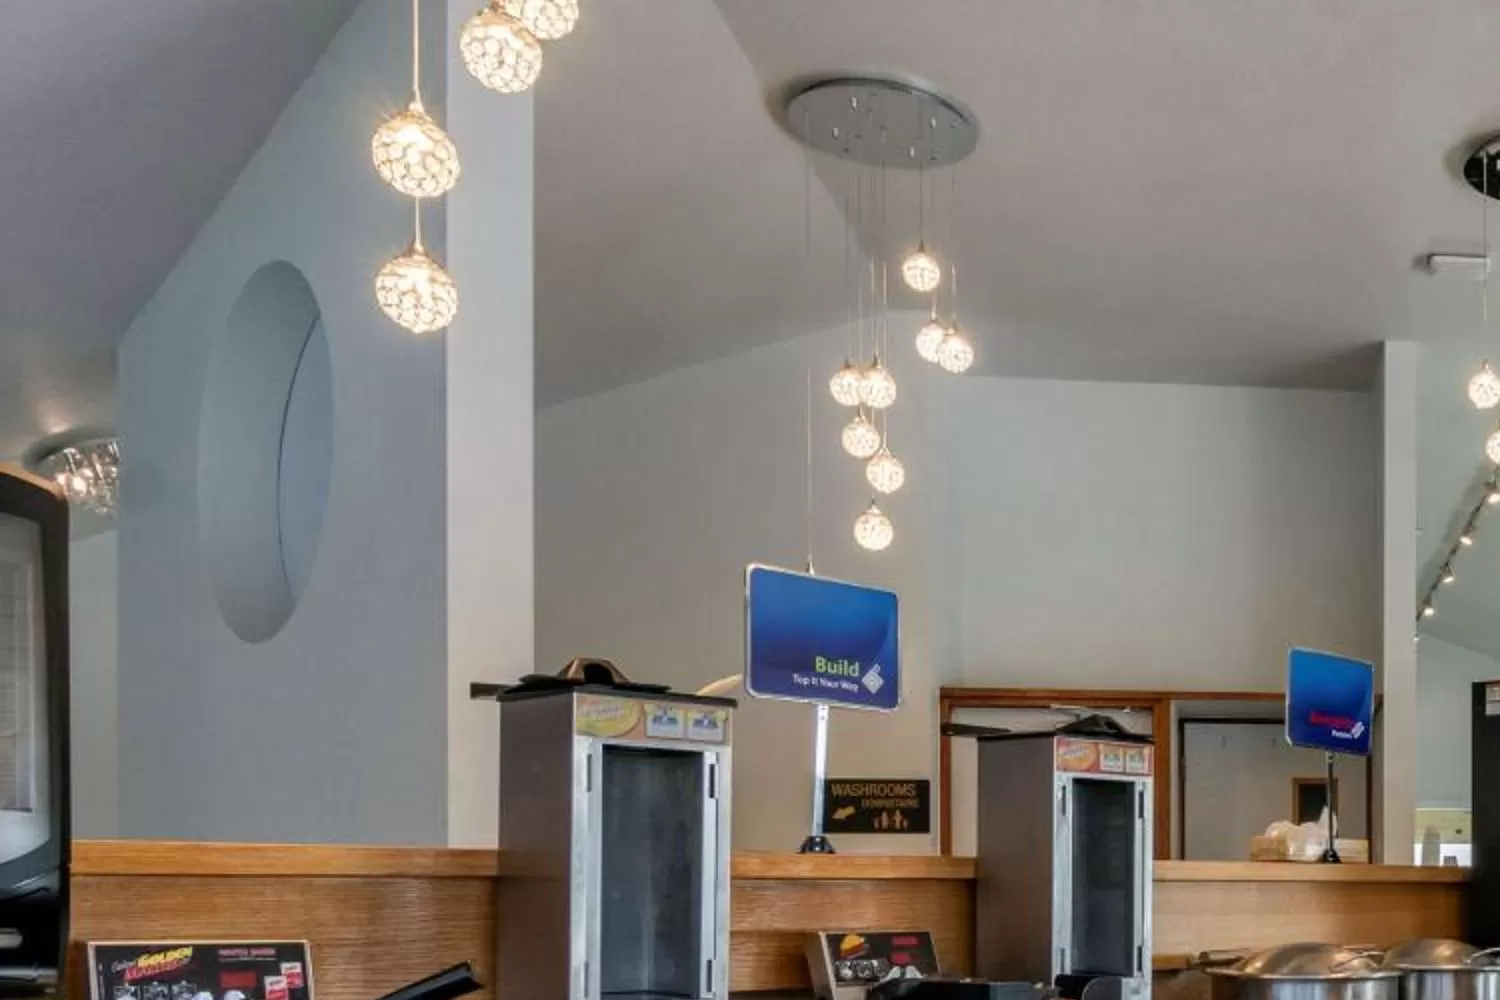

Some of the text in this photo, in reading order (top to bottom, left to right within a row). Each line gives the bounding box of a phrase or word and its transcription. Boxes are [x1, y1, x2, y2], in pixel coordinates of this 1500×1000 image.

[814, 655, 860, 677] Build
[792, 673, 811, 687] Top
[831, 783, 917, 798] WASHROOMS
